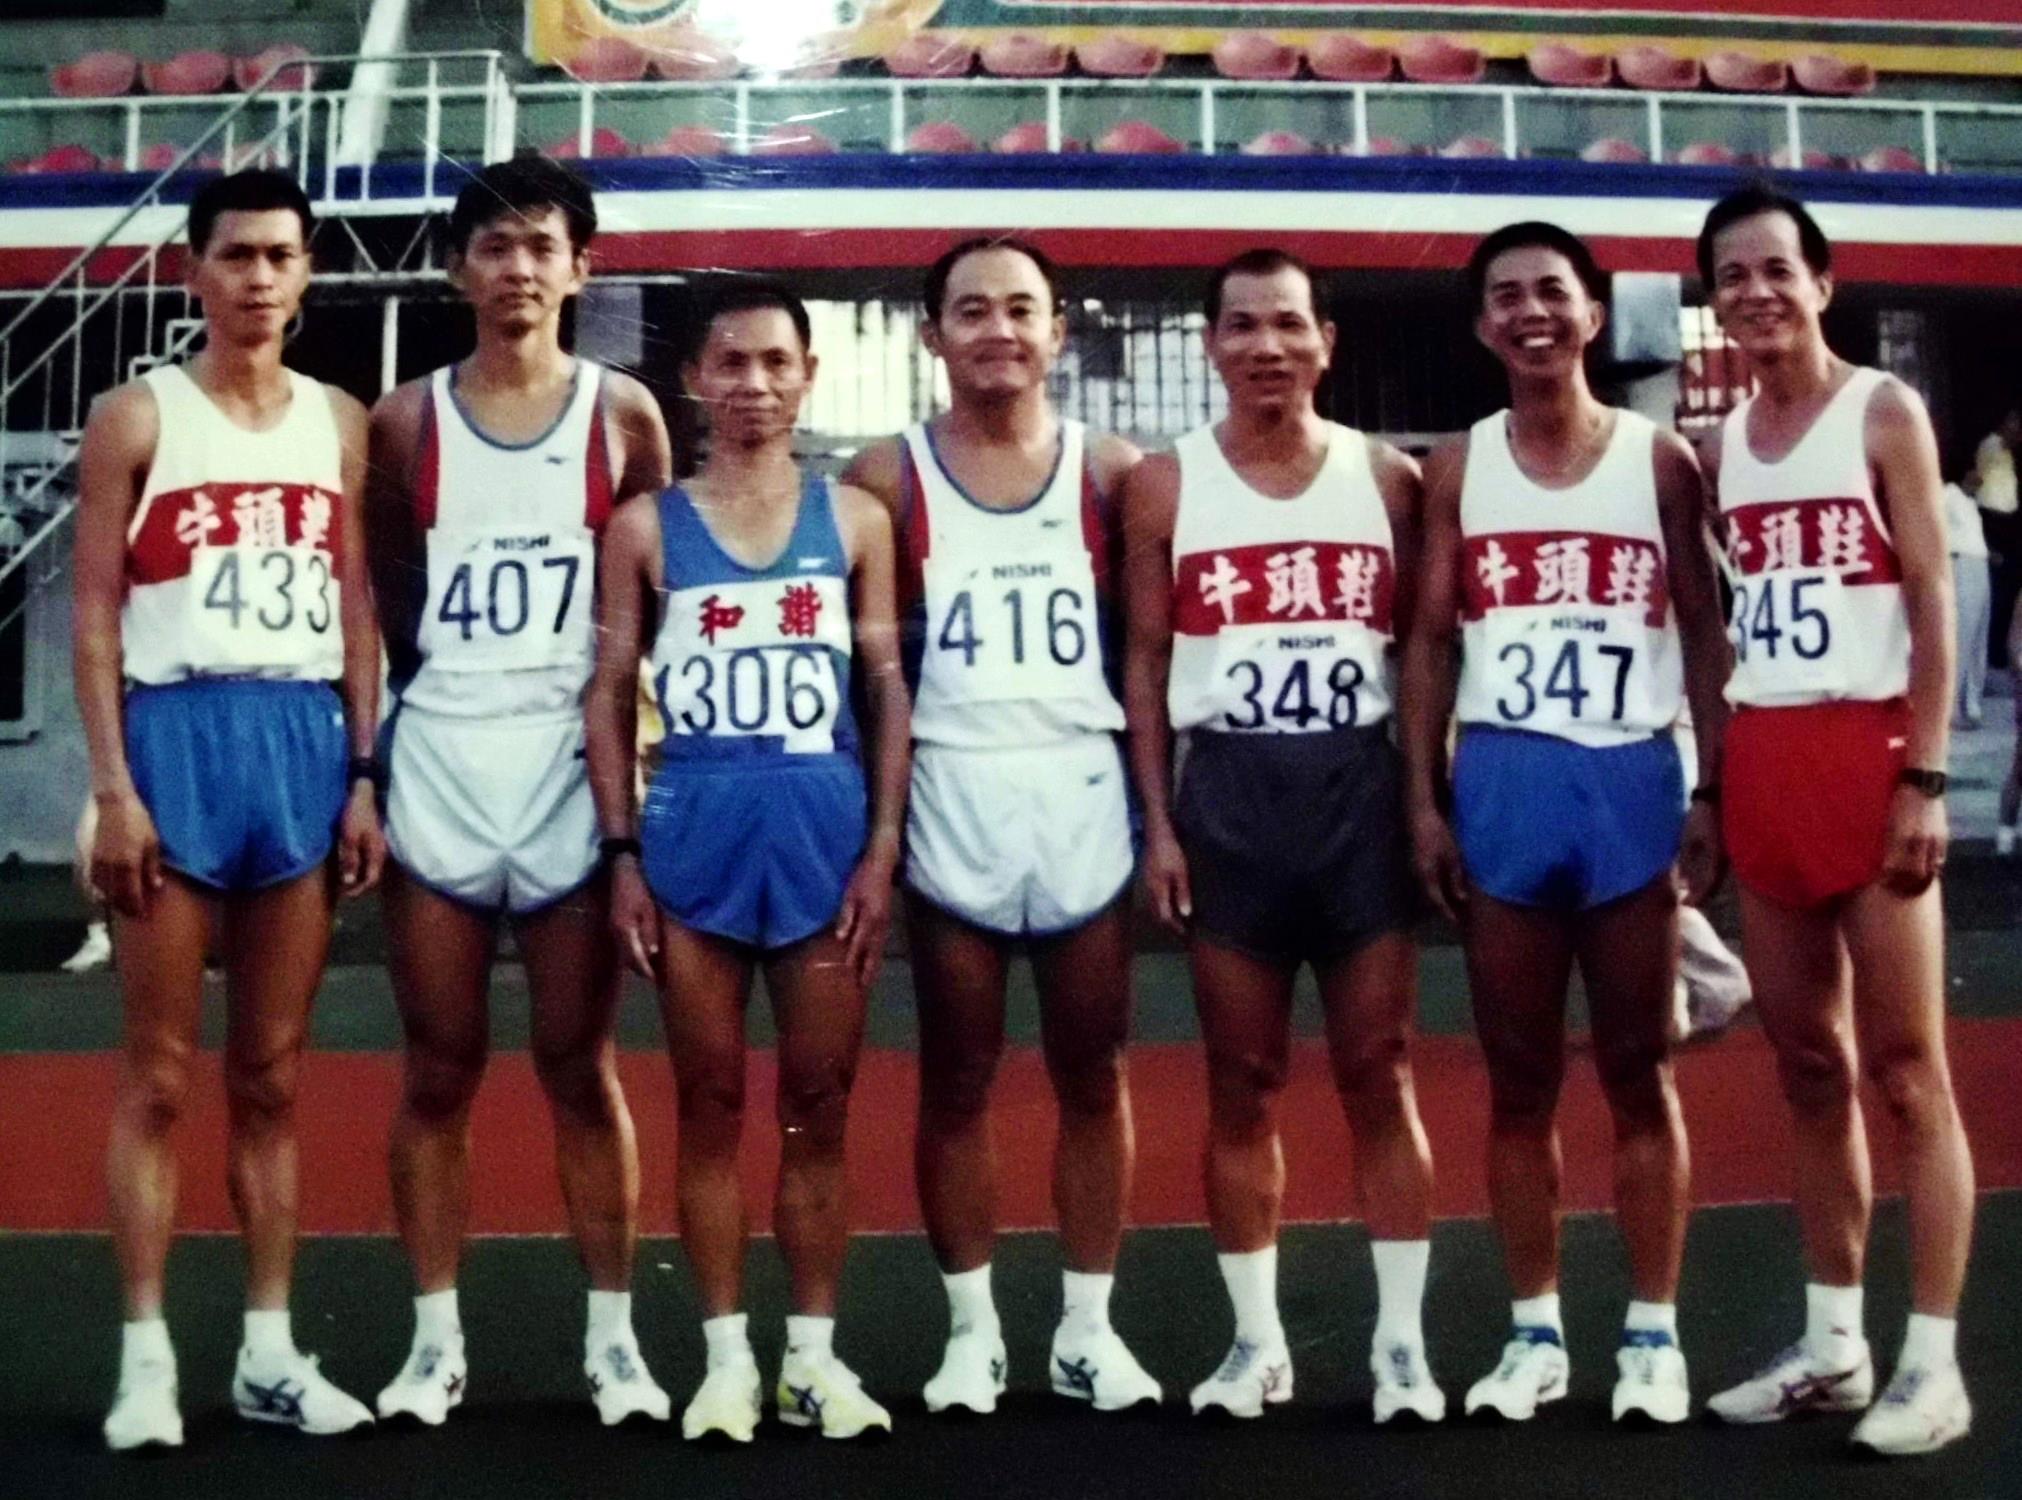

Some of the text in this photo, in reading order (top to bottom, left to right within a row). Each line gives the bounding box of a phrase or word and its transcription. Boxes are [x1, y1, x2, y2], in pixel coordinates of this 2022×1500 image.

[493, 534, 551, 550] NISHI
[992, 564, 1053, 579] NISHI
[203, 551, 332, 634] 433
[438, 556, 579, 640] 407
[938, 587, 1086, 667] 416
[1551, 617, 1606, 632] NISHI
[1277, 636, 1336, 650] NISHI
[1497, 639, 1634, 721] 347
[681, 647, 825, 732] 306
[1224, 658, 1364, 729] 348
